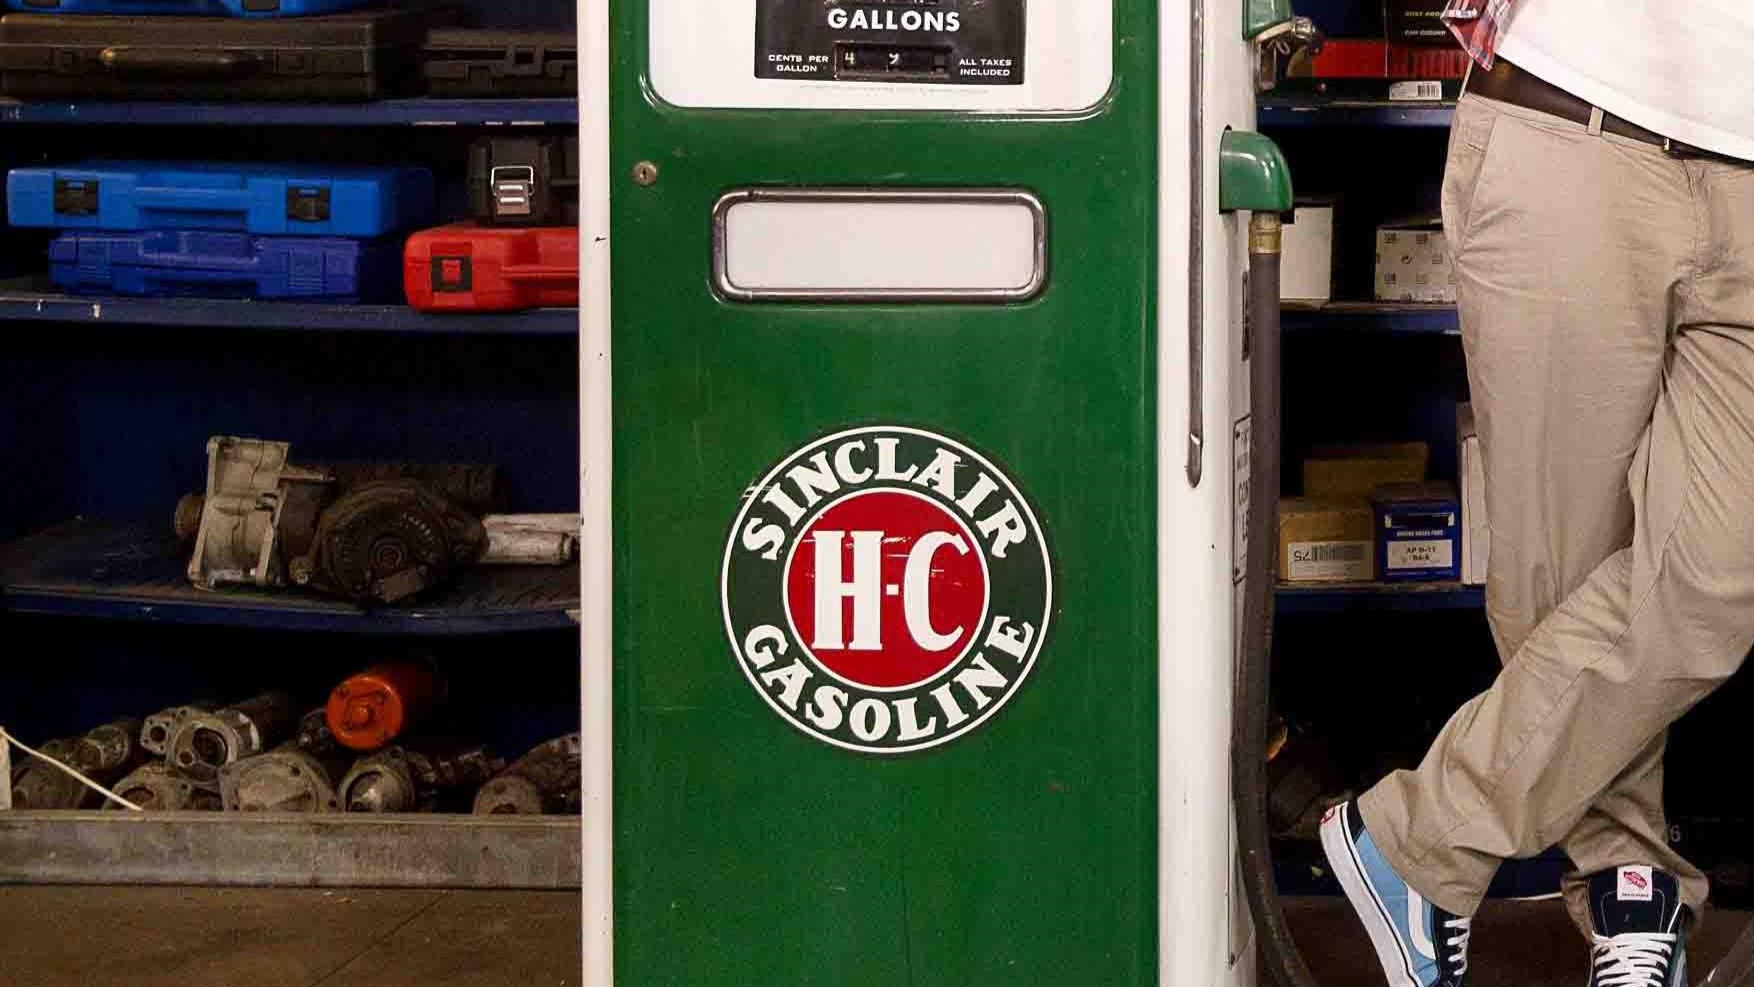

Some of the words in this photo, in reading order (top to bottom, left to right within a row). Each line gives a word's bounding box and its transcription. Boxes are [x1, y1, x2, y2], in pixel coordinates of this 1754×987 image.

[827, 9, 960, 32] GALLONS
[768, 54, 803, 63] CENTS
[808, 55, 829, 63] PER
[959, 58, 977, 66] ALL
[980, 58, 1012, 67] TAXES
[776, 64, 818, 73] GALLON
[959, 68, 1011, 77] INCLUDED
[742, 437, 1028, 561] SINCLAIR
[811, 530, 970, 652] H-C
[745, 616, 1034, 742] GASOLINE
